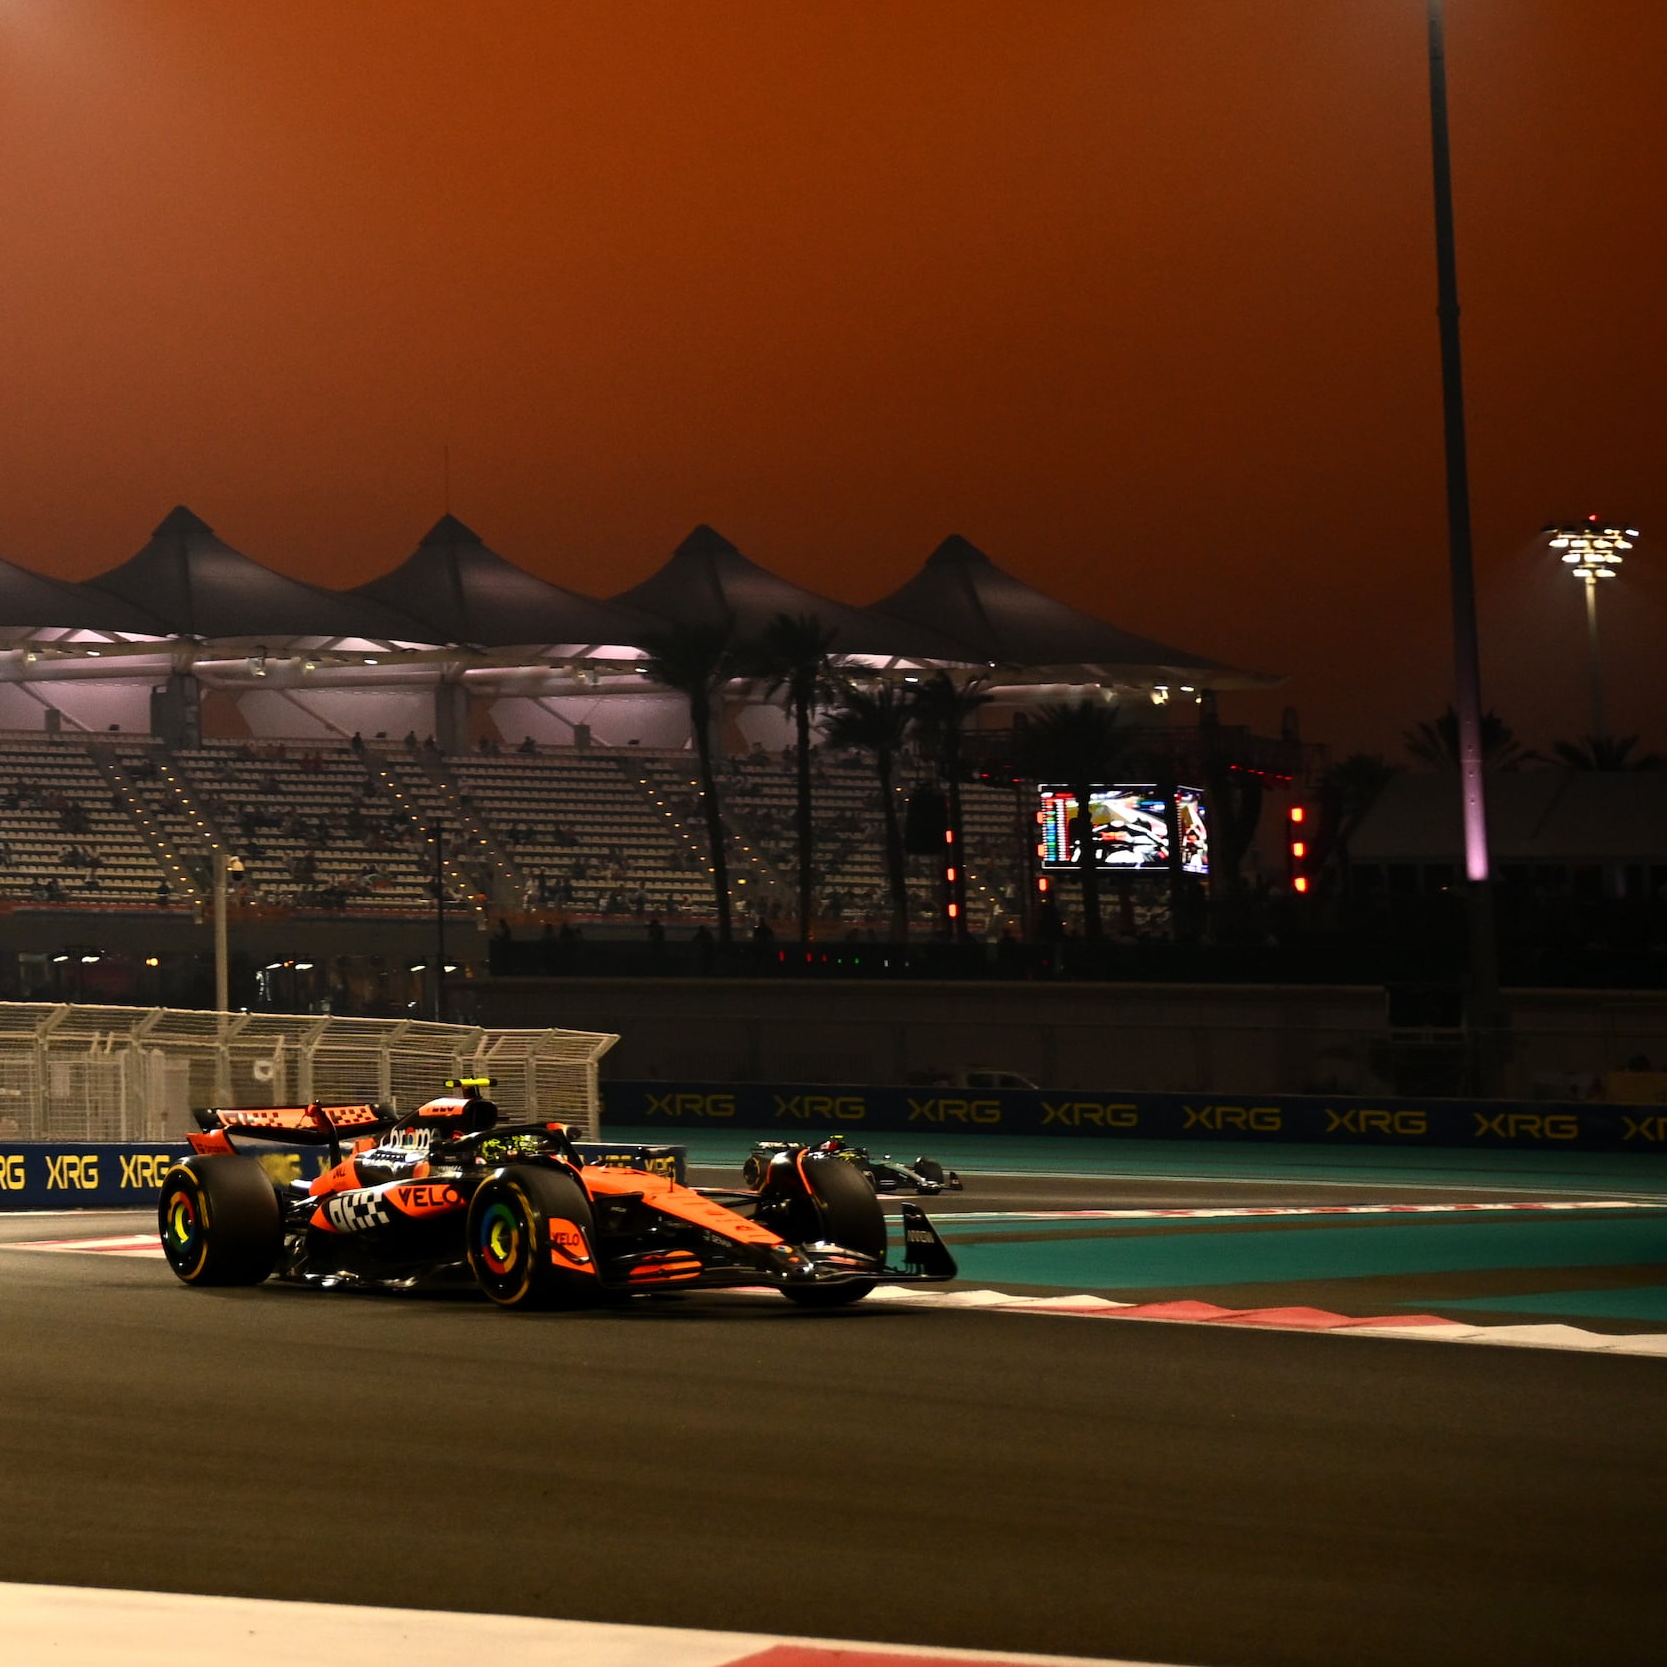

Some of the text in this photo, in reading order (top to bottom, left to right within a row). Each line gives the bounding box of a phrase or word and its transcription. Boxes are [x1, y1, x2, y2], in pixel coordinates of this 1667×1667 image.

[644, 1093, 737, 1118] XRG
[772, 1095, 867, 1119] XRG
[907, 1099, 1002, 1123] XRG
[1041, 1102, 1139, 1127] XRG
[1182, 1106, 1283, 1131] XRG
[1325, 1109, 1429, 1135] XRG
[1473, 1113, 1580, 1140] XRG
[44, 1154, 100, 1190] XRG
[397, 1184, 461, 1207] VELO
